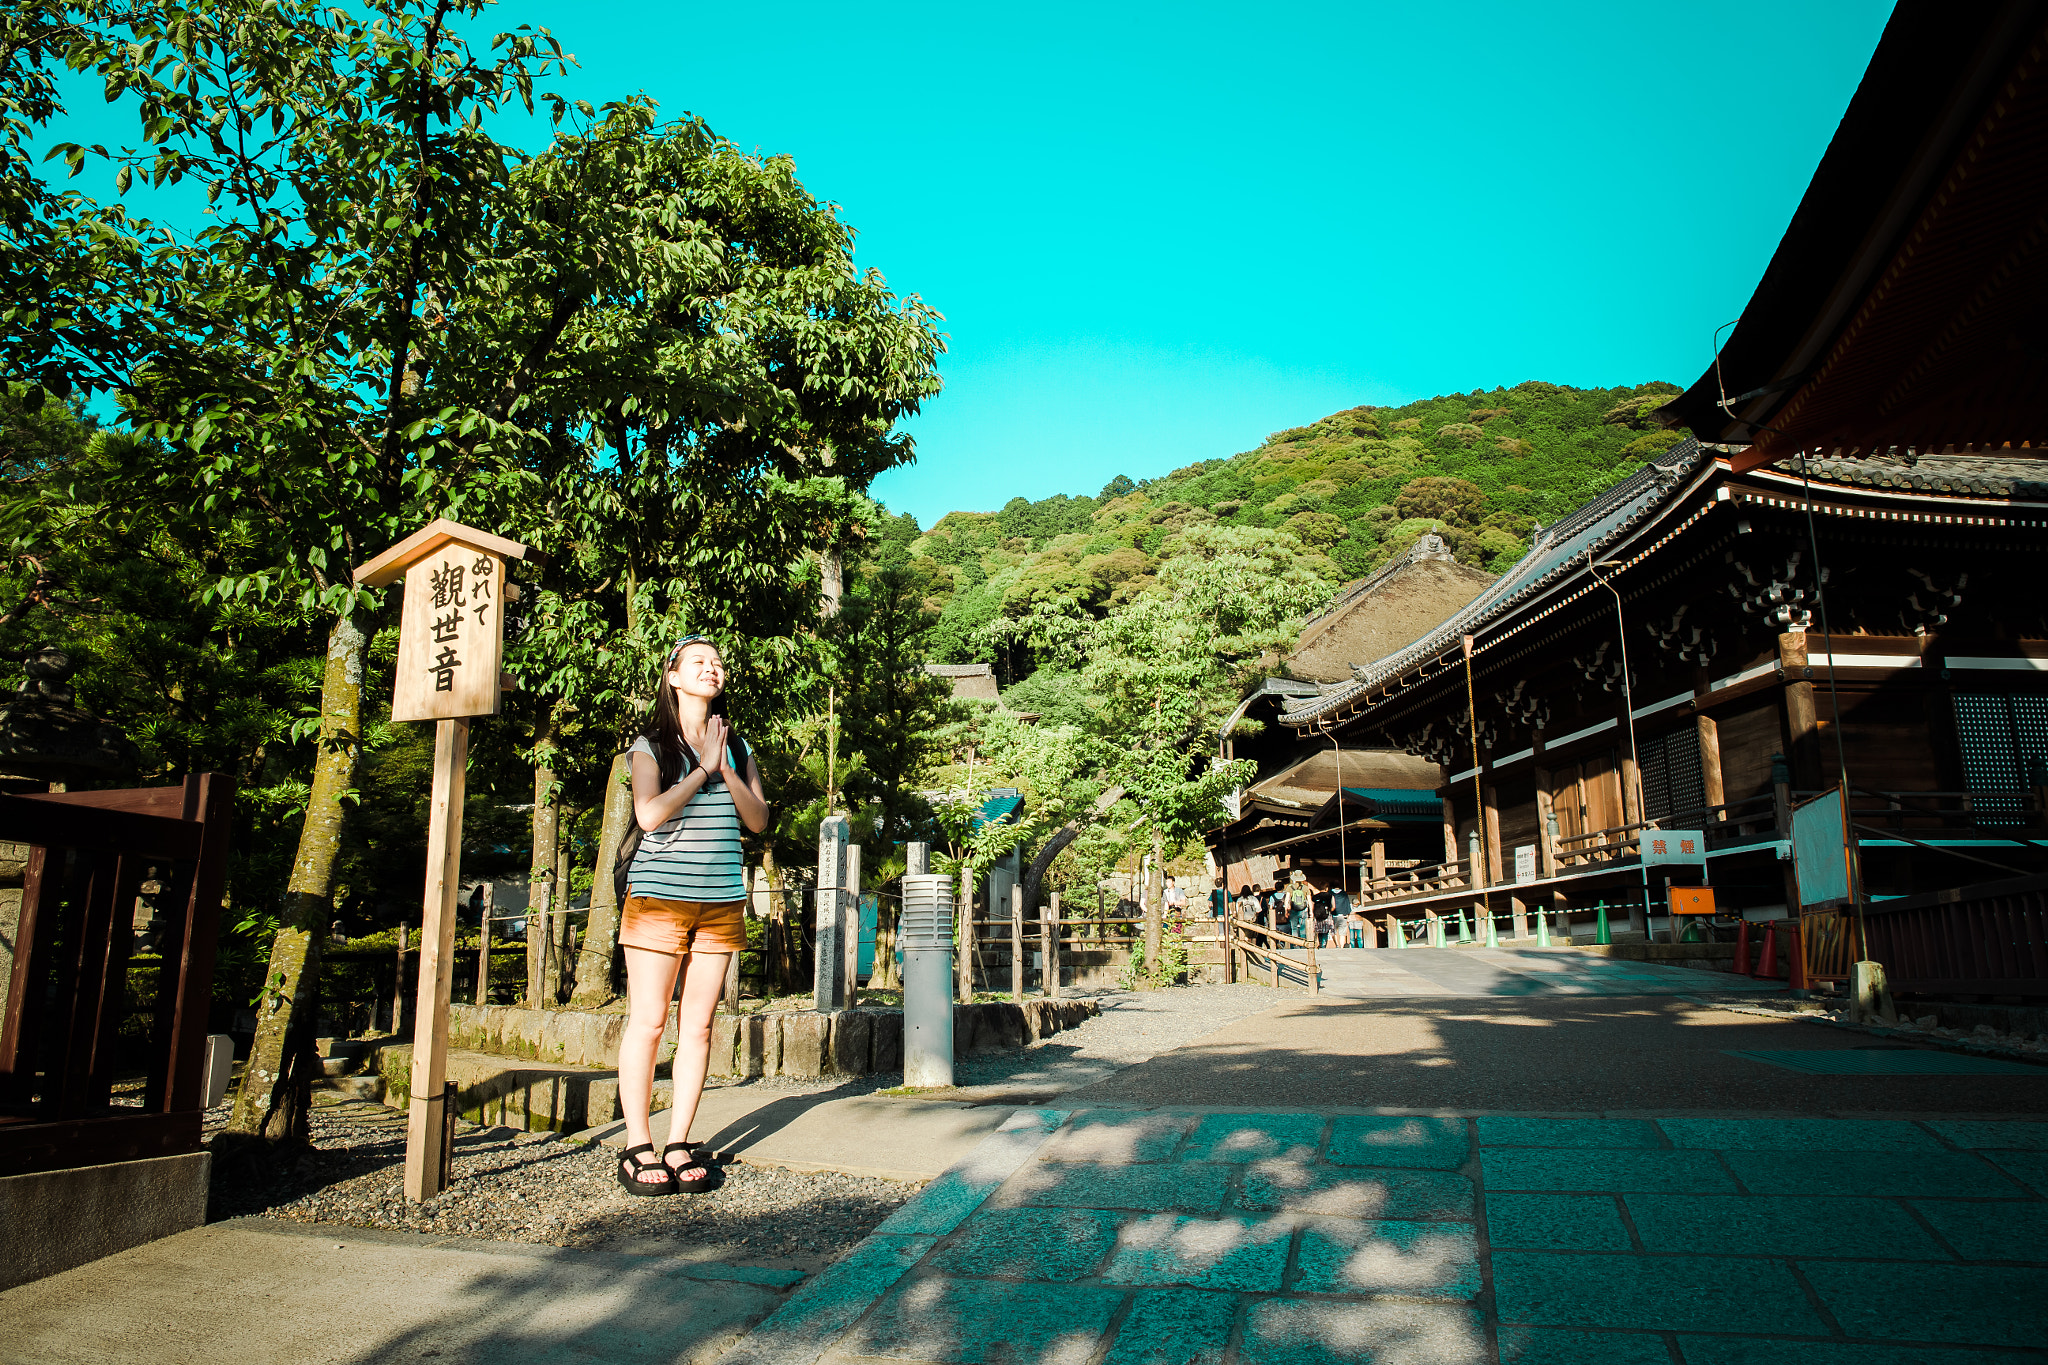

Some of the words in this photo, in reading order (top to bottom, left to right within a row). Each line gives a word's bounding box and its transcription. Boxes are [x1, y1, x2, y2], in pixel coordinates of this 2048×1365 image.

[471, 554, 493, 626] ぬれて
[1652, 839, 1696, 855] 禁煙
